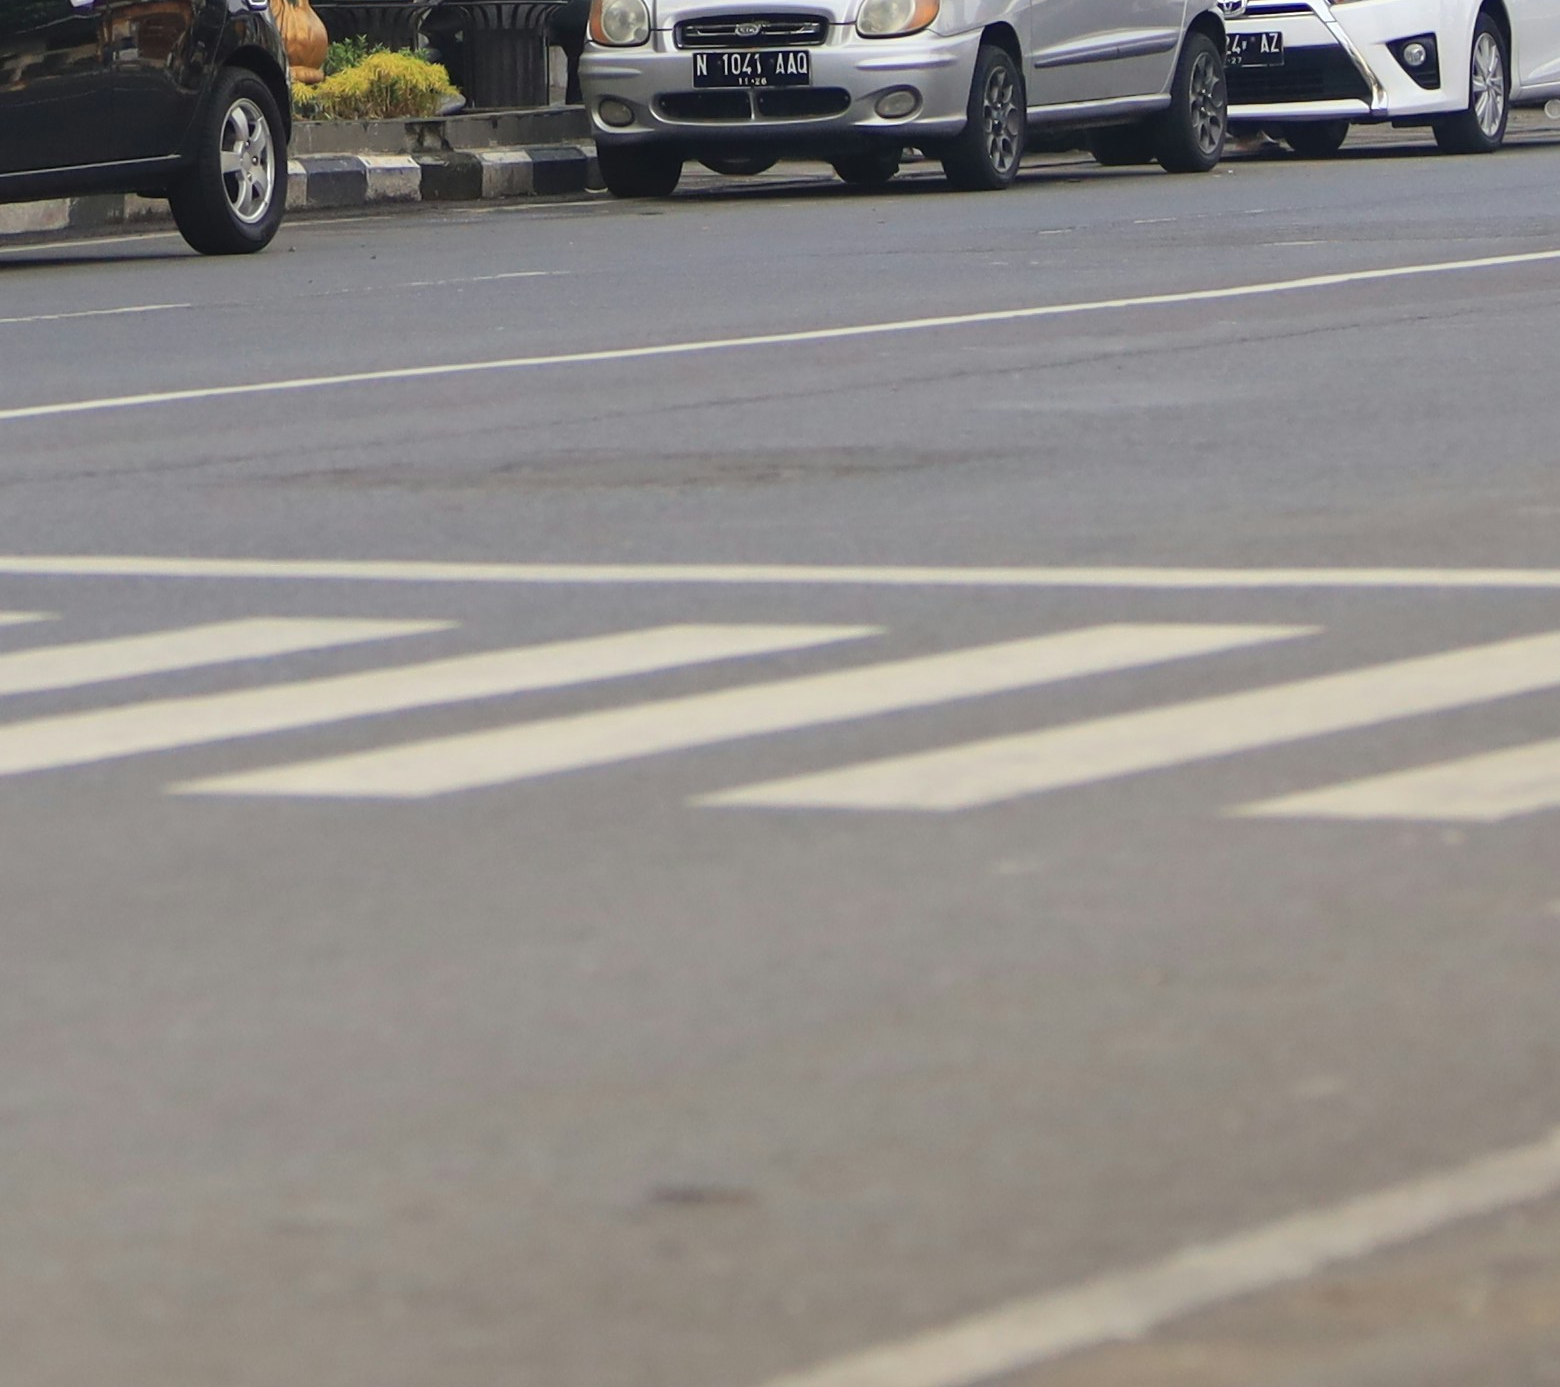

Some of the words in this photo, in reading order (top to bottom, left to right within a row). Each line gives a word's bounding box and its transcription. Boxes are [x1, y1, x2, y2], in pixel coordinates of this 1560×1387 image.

[1261, 32, 1280, 53] AZ
[696, 54, 707, 76] N
[722, 53, 761, 75] 1041
[775, 52, 808, 75] AAQ
